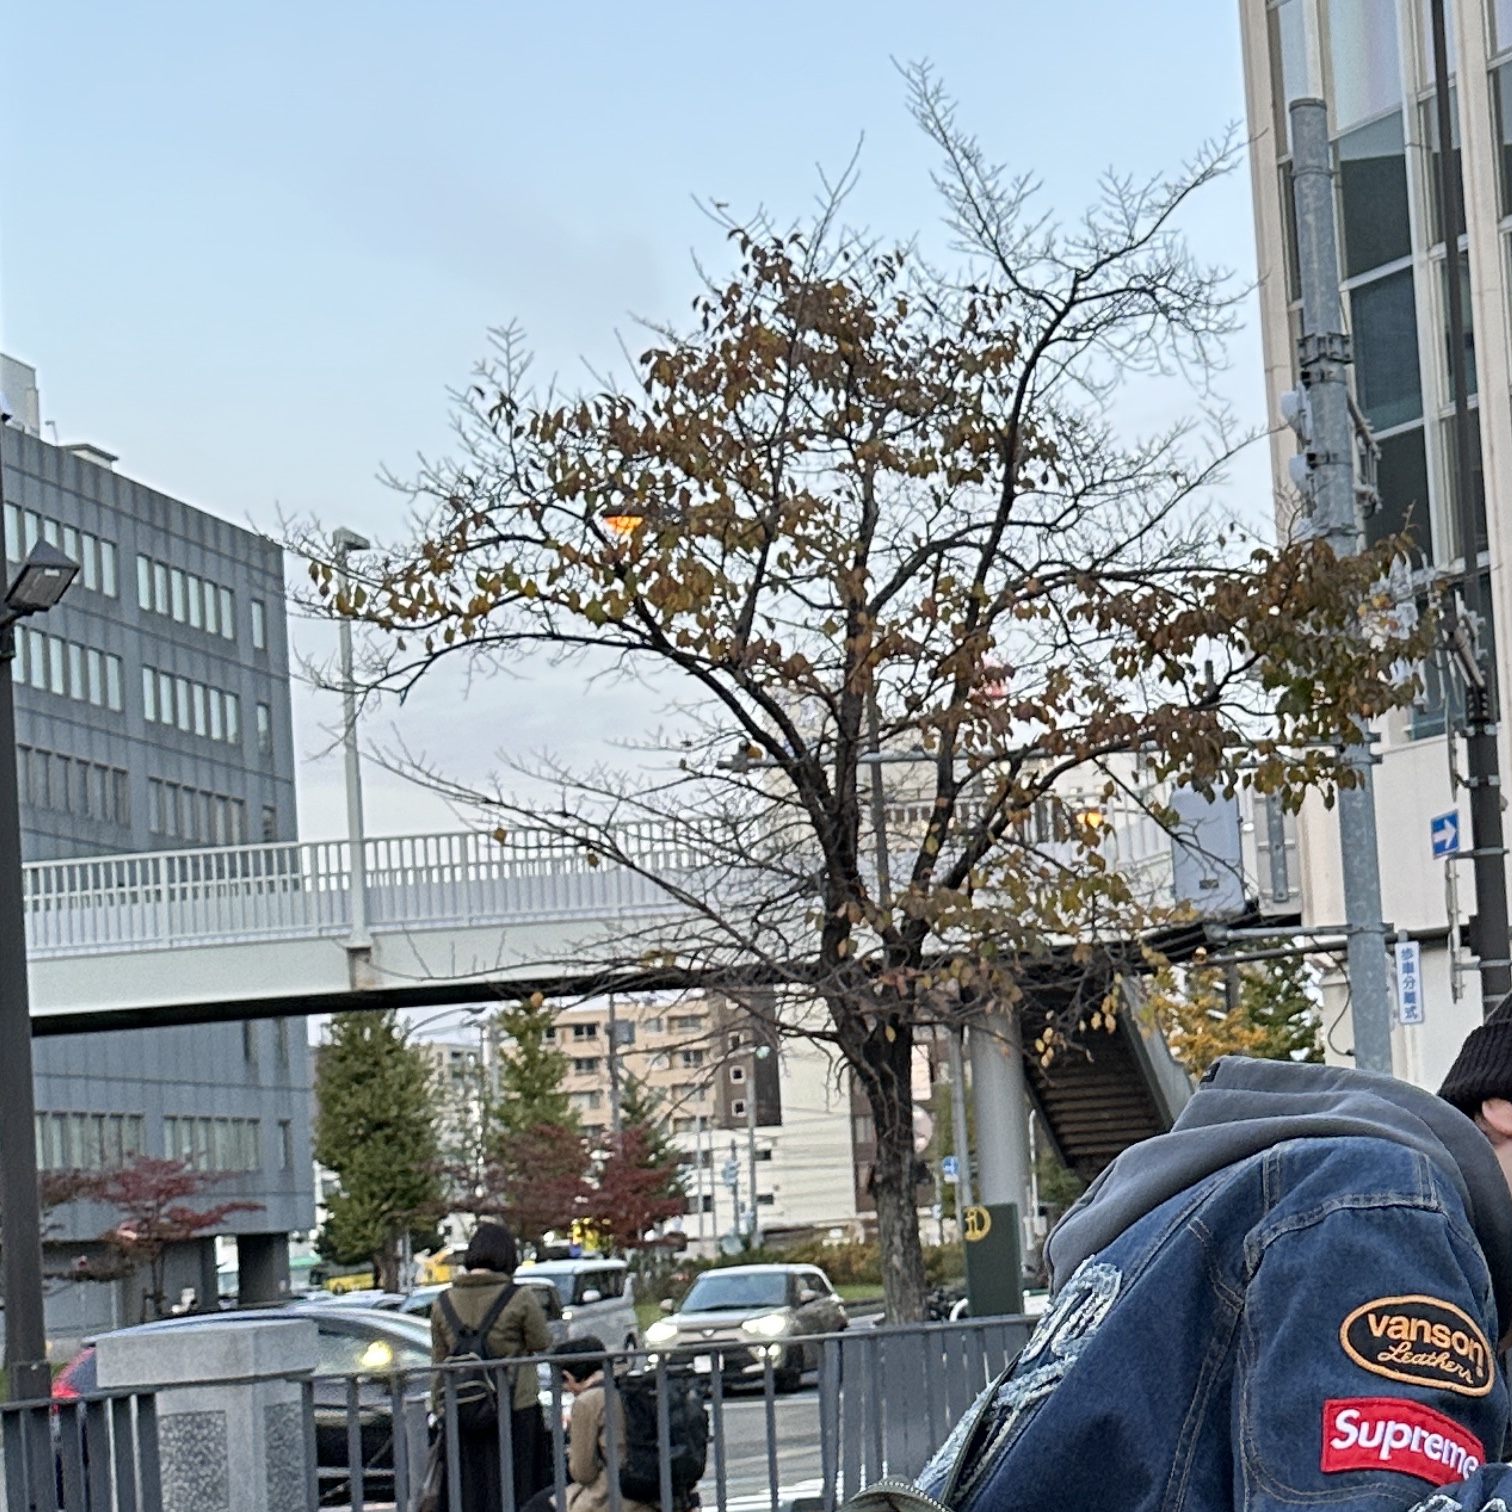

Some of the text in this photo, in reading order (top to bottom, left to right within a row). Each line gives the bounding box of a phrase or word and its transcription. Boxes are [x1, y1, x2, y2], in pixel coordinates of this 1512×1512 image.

[1400, 947, 1418, 1020] 歩車分離式
[1367, 1313, 1484, 1371] vanson
[1377, 1341, 1474, 1384] Leathers
[1330, 1408, 1480, 1481] Supreme
